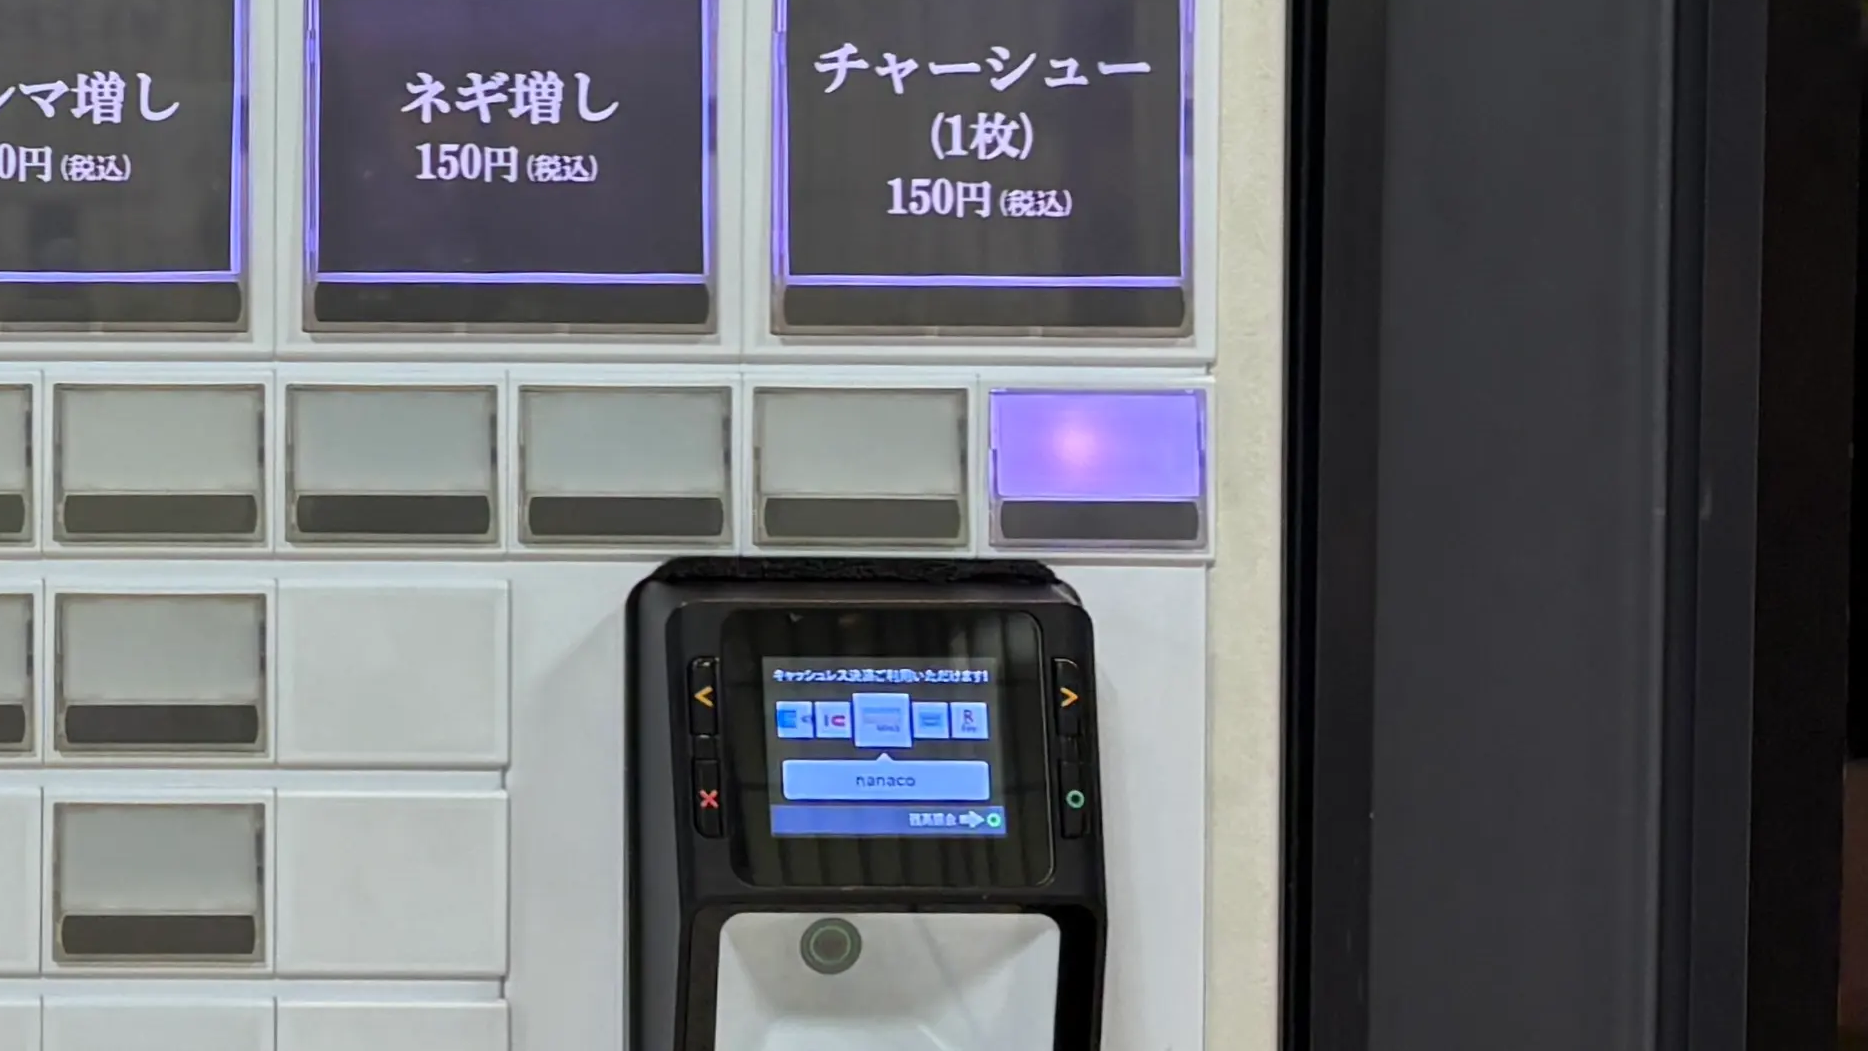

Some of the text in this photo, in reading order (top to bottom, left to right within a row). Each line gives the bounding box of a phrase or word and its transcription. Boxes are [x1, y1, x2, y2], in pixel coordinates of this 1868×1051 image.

[814, 43, 1151, 94] チャーシュー
[401, 71, 619, 124] ネギ増し
[931, 112, 1033, 160] (1枚)
[856, 775, 916, 787] nanaco
